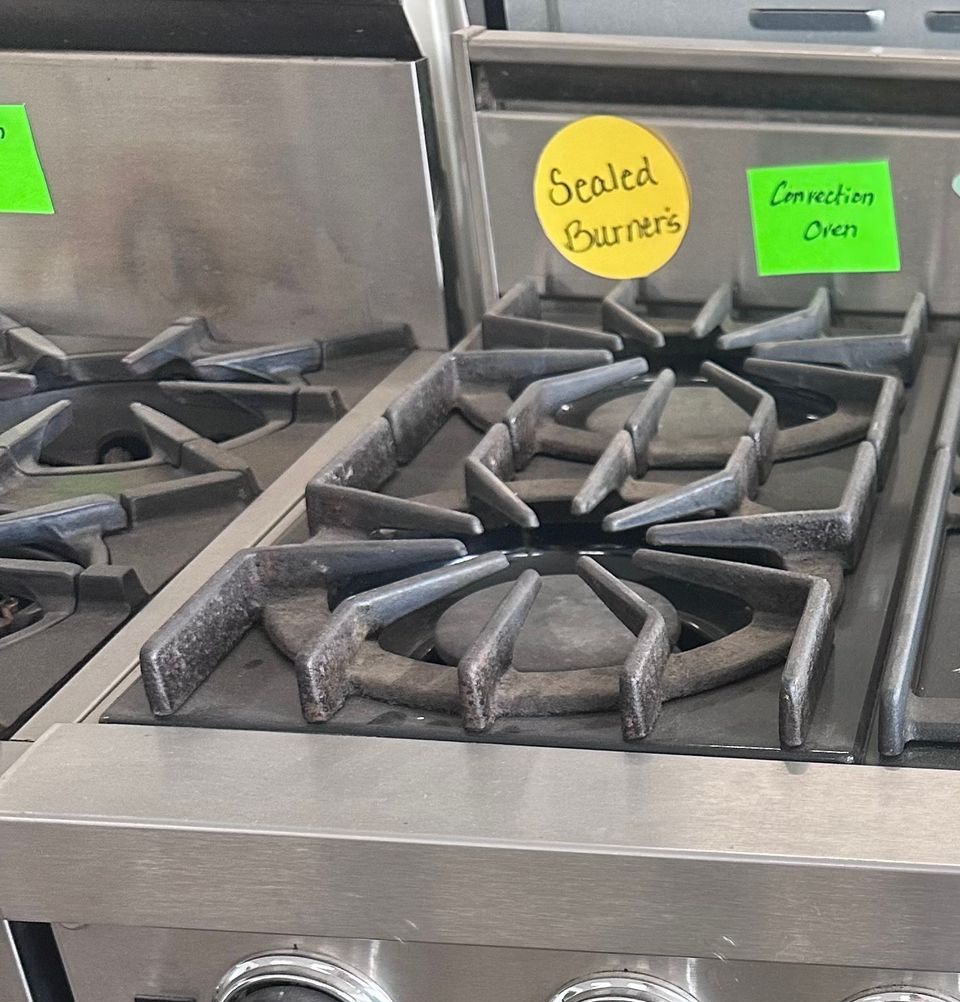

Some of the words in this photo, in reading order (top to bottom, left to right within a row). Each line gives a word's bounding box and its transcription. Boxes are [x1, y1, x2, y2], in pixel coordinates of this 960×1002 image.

[549, 156, 659, 206] Sealed
[769, 180, 875, 207] Convection
[804, 220, 858, 242] Oven
